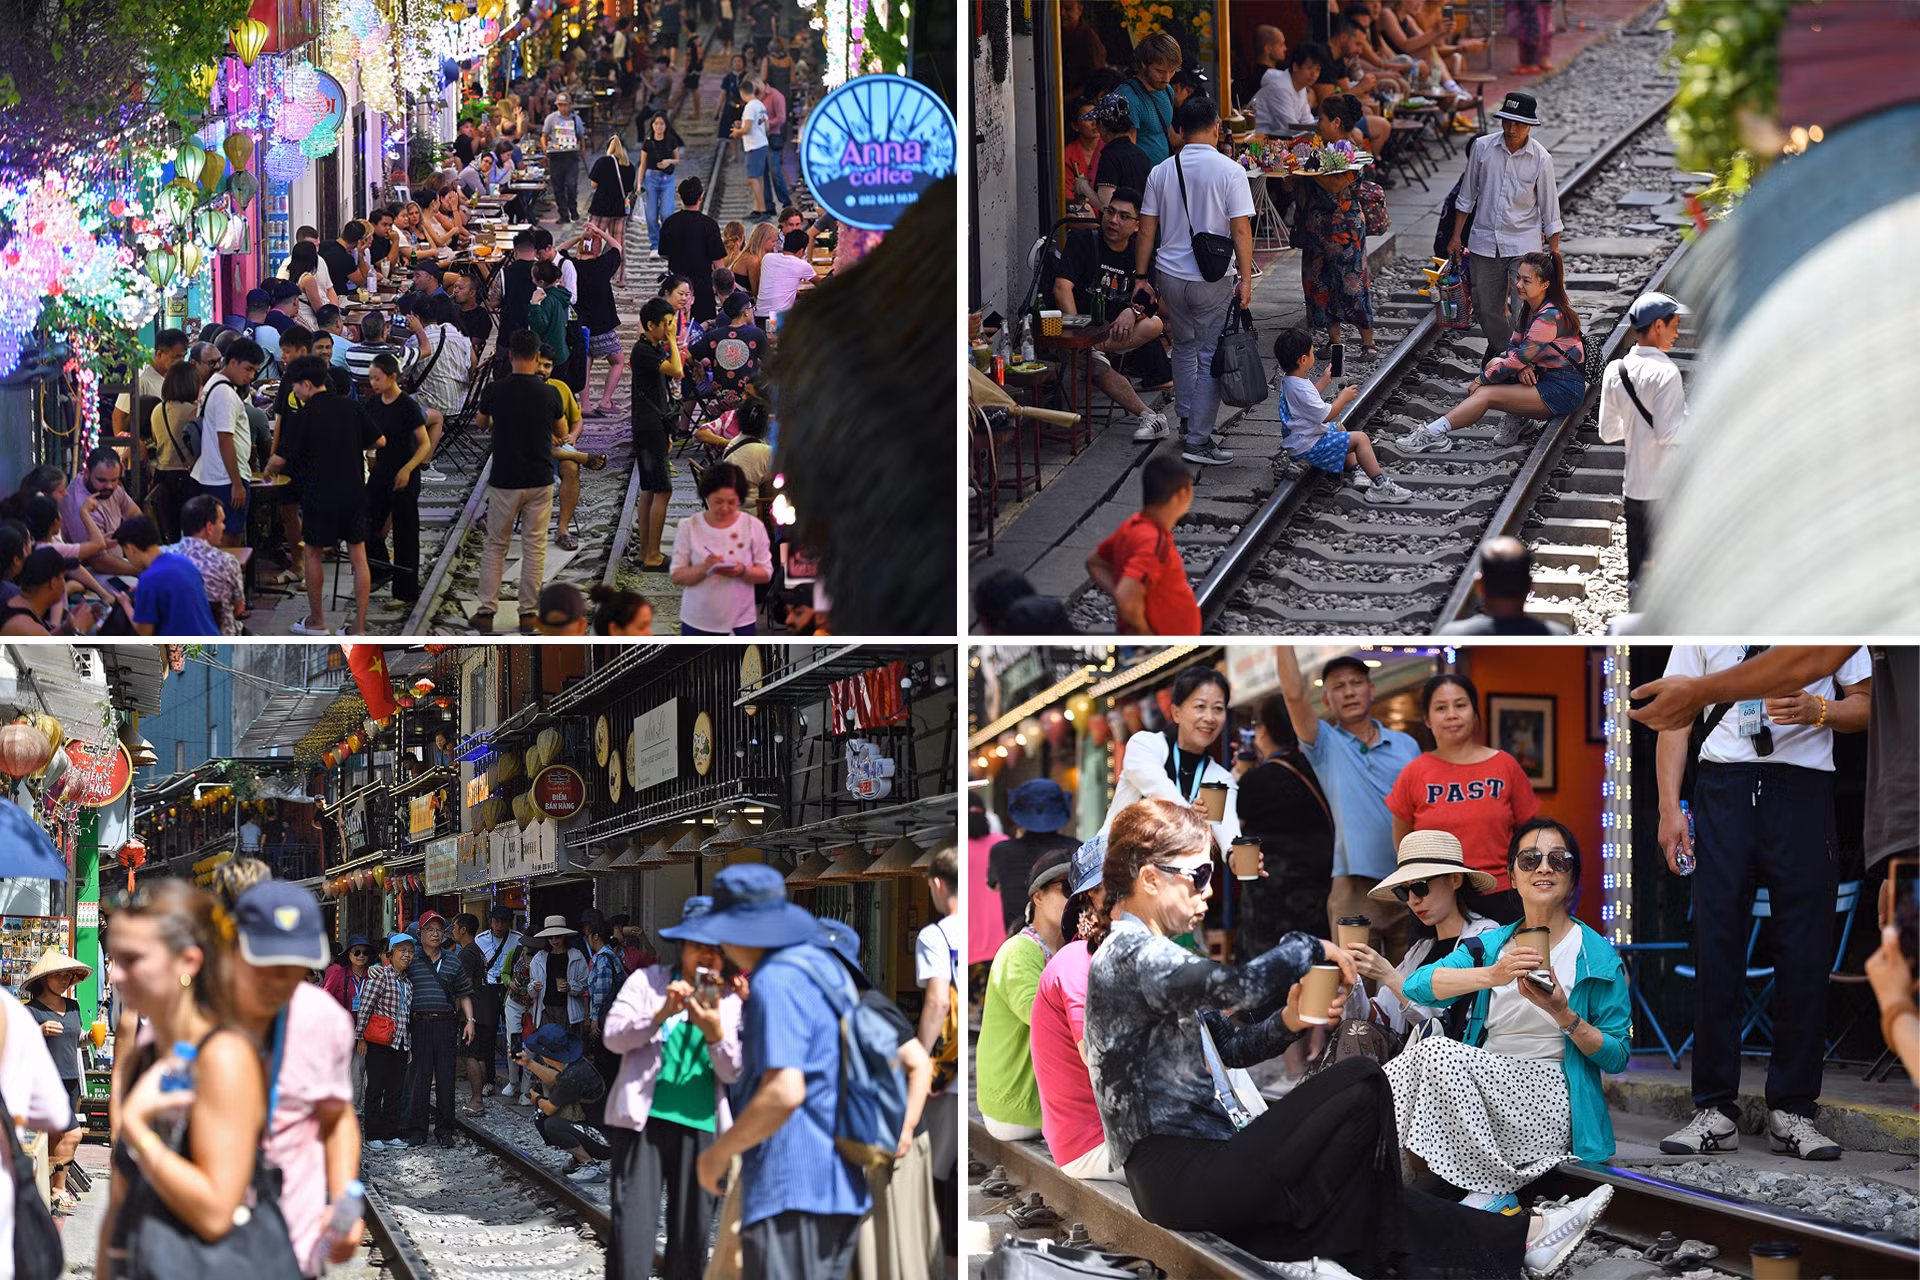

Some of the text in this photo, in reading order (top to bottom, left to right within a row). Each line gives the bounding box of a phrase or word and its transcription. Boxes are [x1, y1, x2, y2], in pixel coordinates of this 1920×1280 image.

[841, 138, 922, 167] Anna
[849, 166, 914, 187] coffee
[1743, 707, 1756, 717] 606
[1425, 777, 1504, 804] PAST
